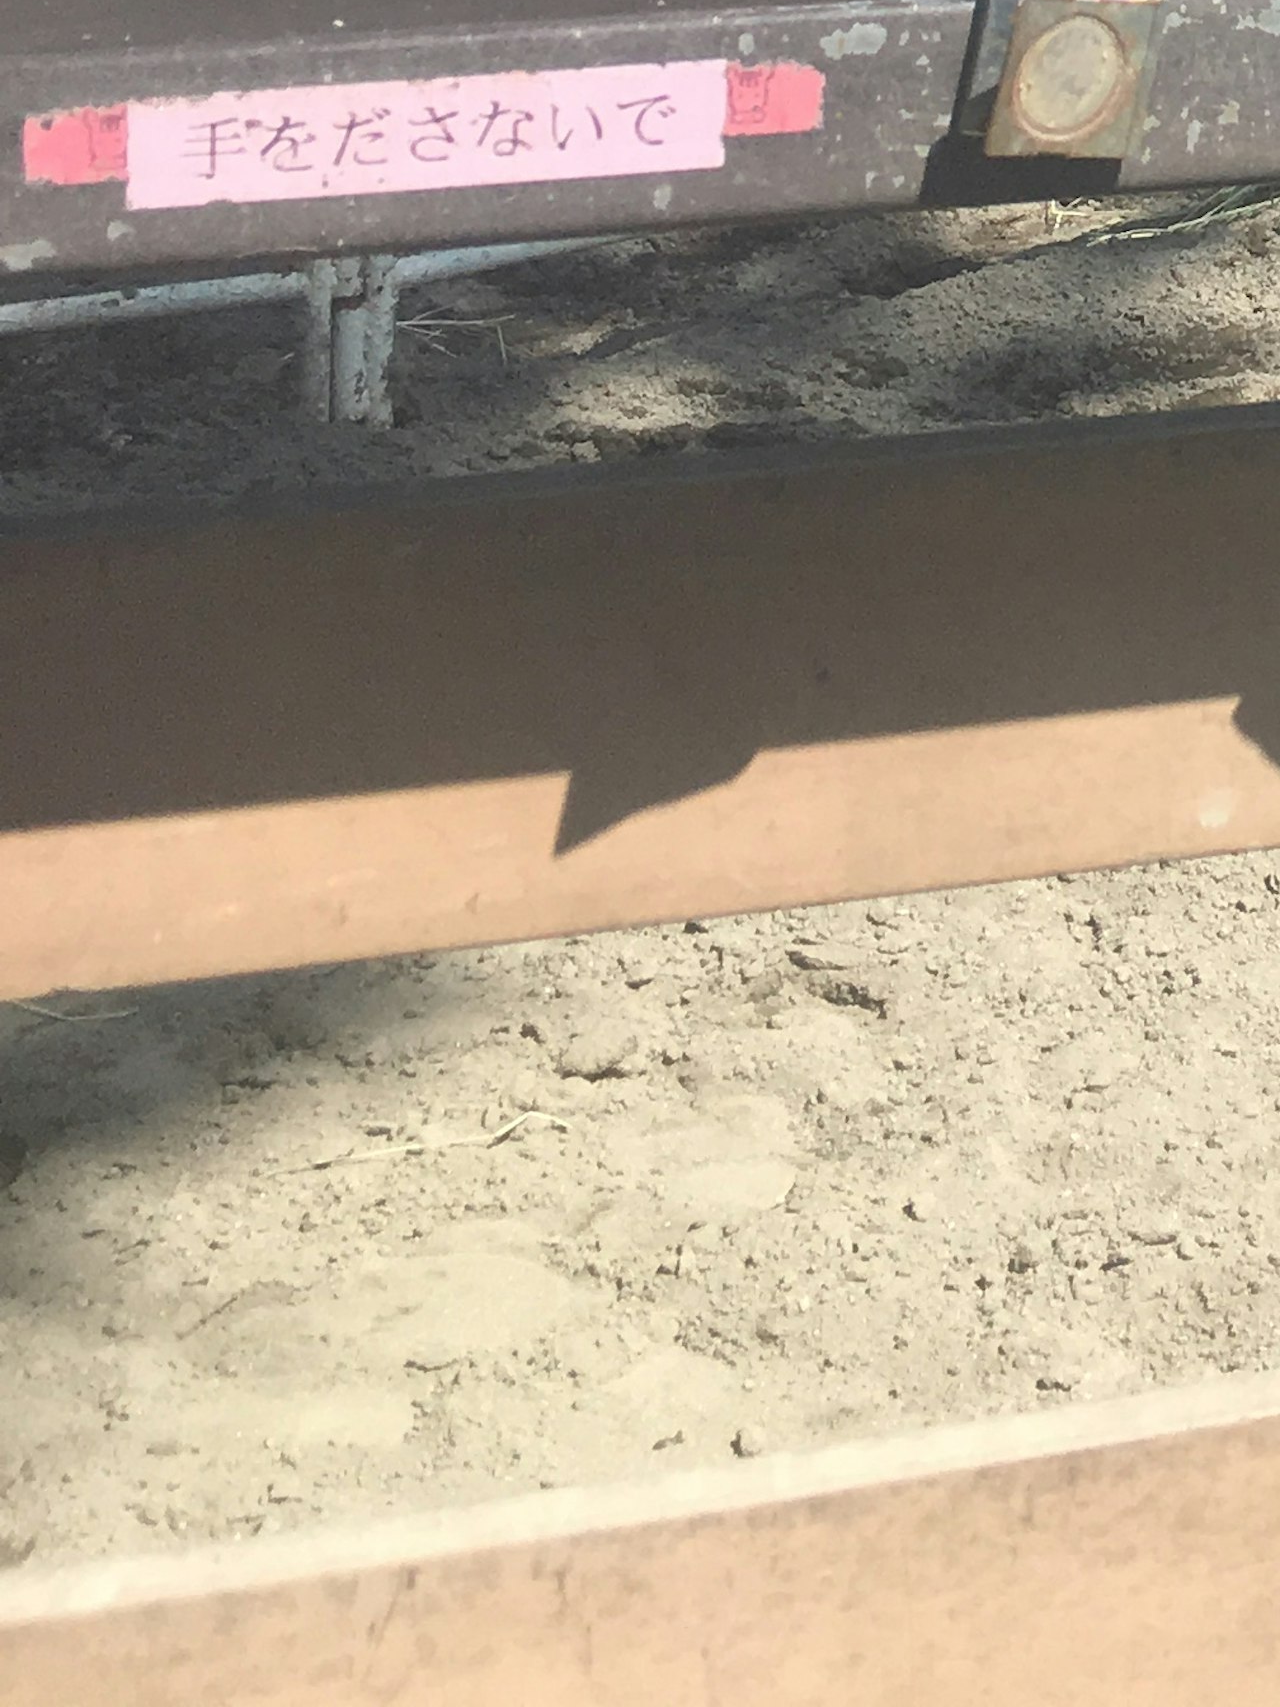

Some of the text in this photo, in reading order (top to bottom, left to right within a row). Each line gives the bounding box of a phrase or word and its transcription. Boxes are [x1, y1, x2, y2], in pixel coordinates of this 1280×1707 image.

[182, 94, 677, 179] 手をださないで
